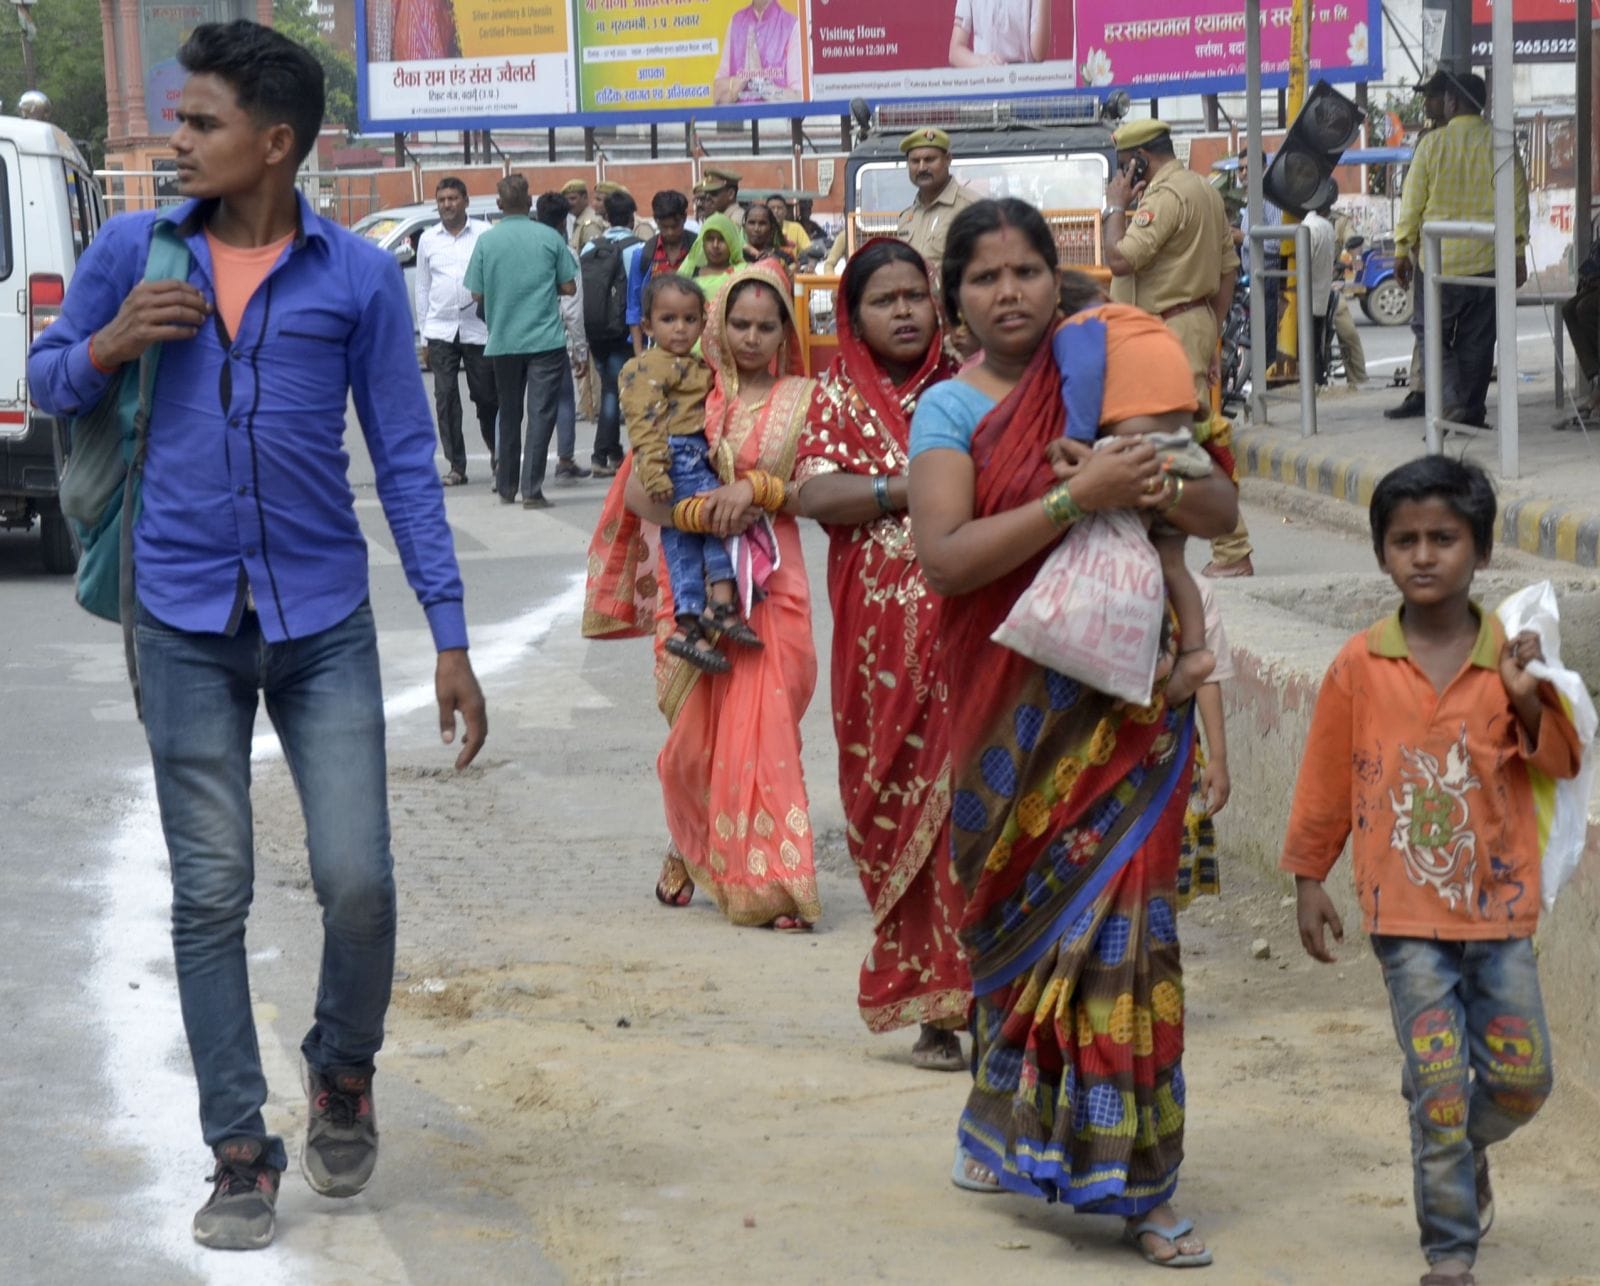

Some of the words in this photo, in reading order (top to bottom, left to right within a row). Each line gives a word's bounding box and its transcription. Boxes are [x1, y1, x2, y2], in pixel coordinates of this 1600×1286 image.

[819, 26, 855, 43] Visiting
[857, 24, 886, 39] Hours
[1104, 17, 1191, 44] हरसहायमल
[843, 44, 855, 57] AM
[856, 46, 865, 56] to
[886, 43, 898, 55] PM
[393, 67, 420, 88] टीका
[425, 69, 445, 87] राम
[470, 62, 492, 84] संस
